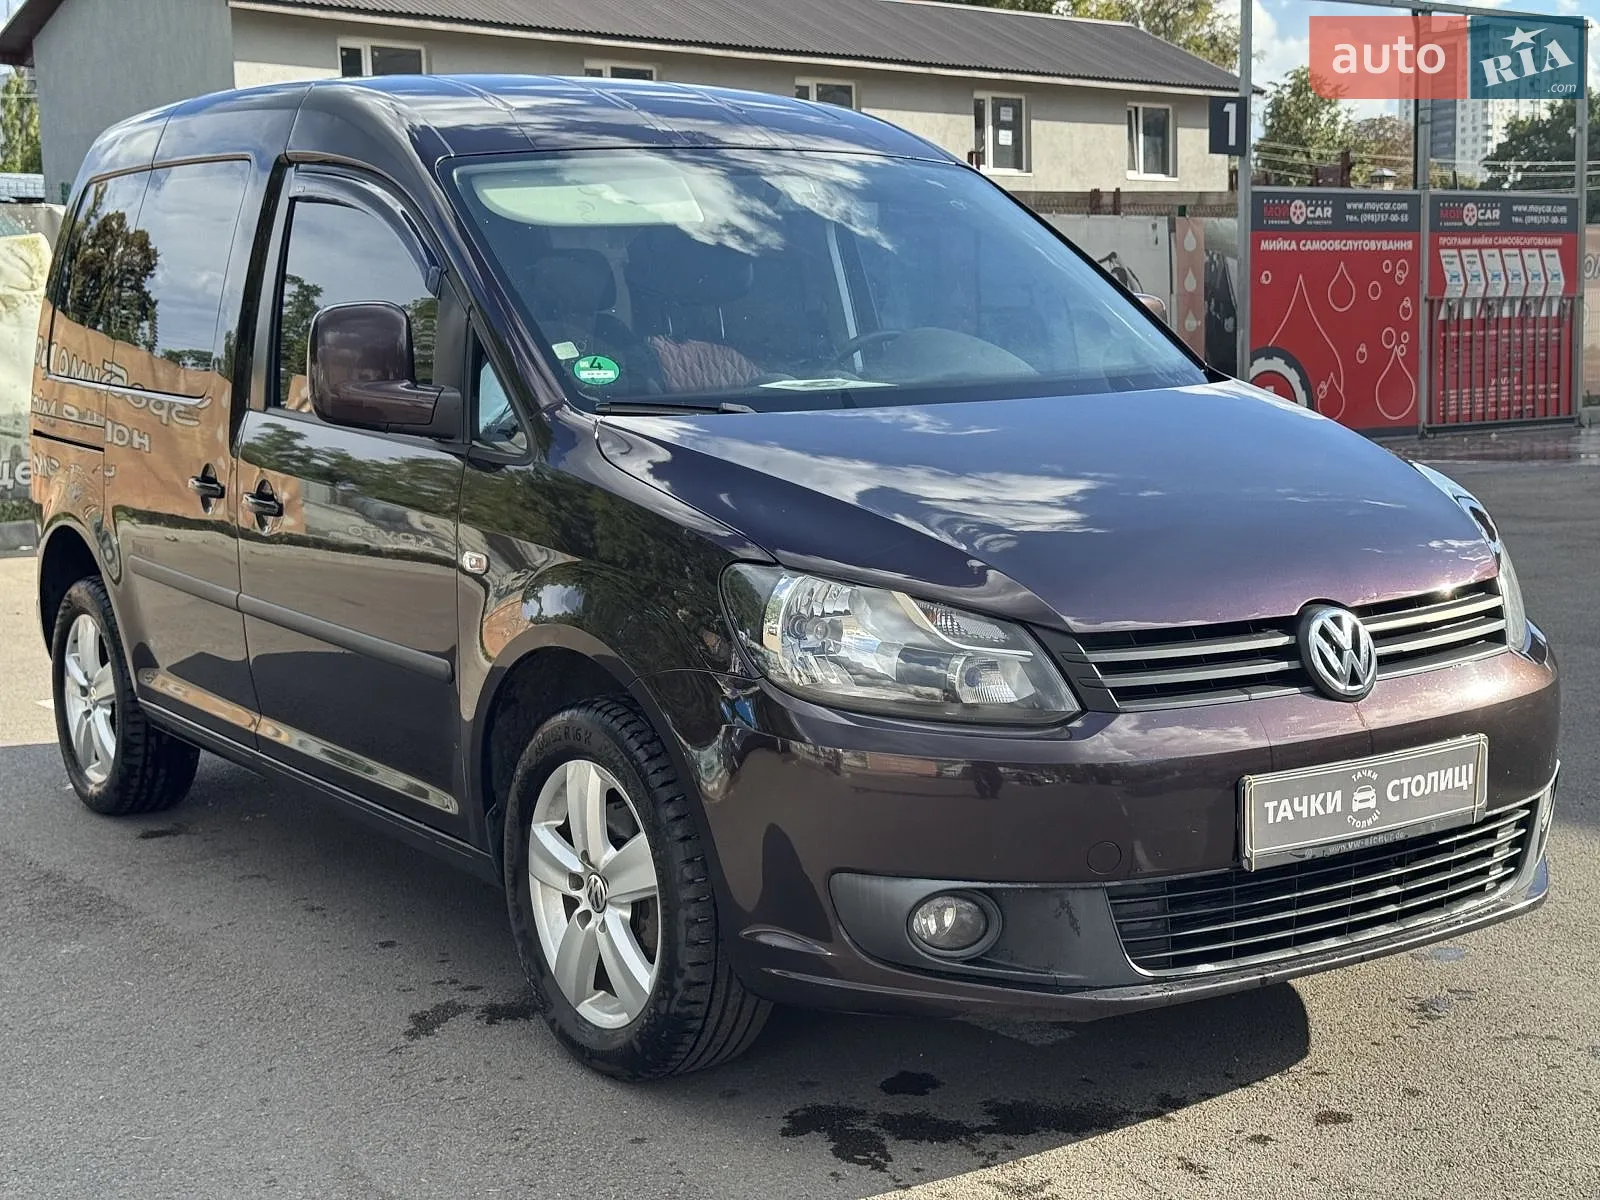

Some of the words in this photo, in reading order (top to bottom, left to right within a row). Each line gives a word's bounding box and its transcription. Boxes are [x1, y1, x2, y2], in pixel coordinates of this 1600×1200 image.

[1222, 102, 1237, 147] 1
[1306, 206, 1333, 218] CAR
[1346, 202, 1408, 212] www.moycar.com
[1477, 208, 1501, 220] CAR
[1260, 237, 1297, 251] МИЙКА
[1299, 239, 1413, 251] САМООБСЛУГОВУВАННЯ
[589, 356, 604, 370] 4
[1352, 769, 1379, 782] ТАЧКИ
[1264, 789, 1342, 824] ТАЧКИ
[1386, 763, 1474, 802] СТОЛИЦІ
[1347, 809, 1381, 829] СТОЛИЦІ
